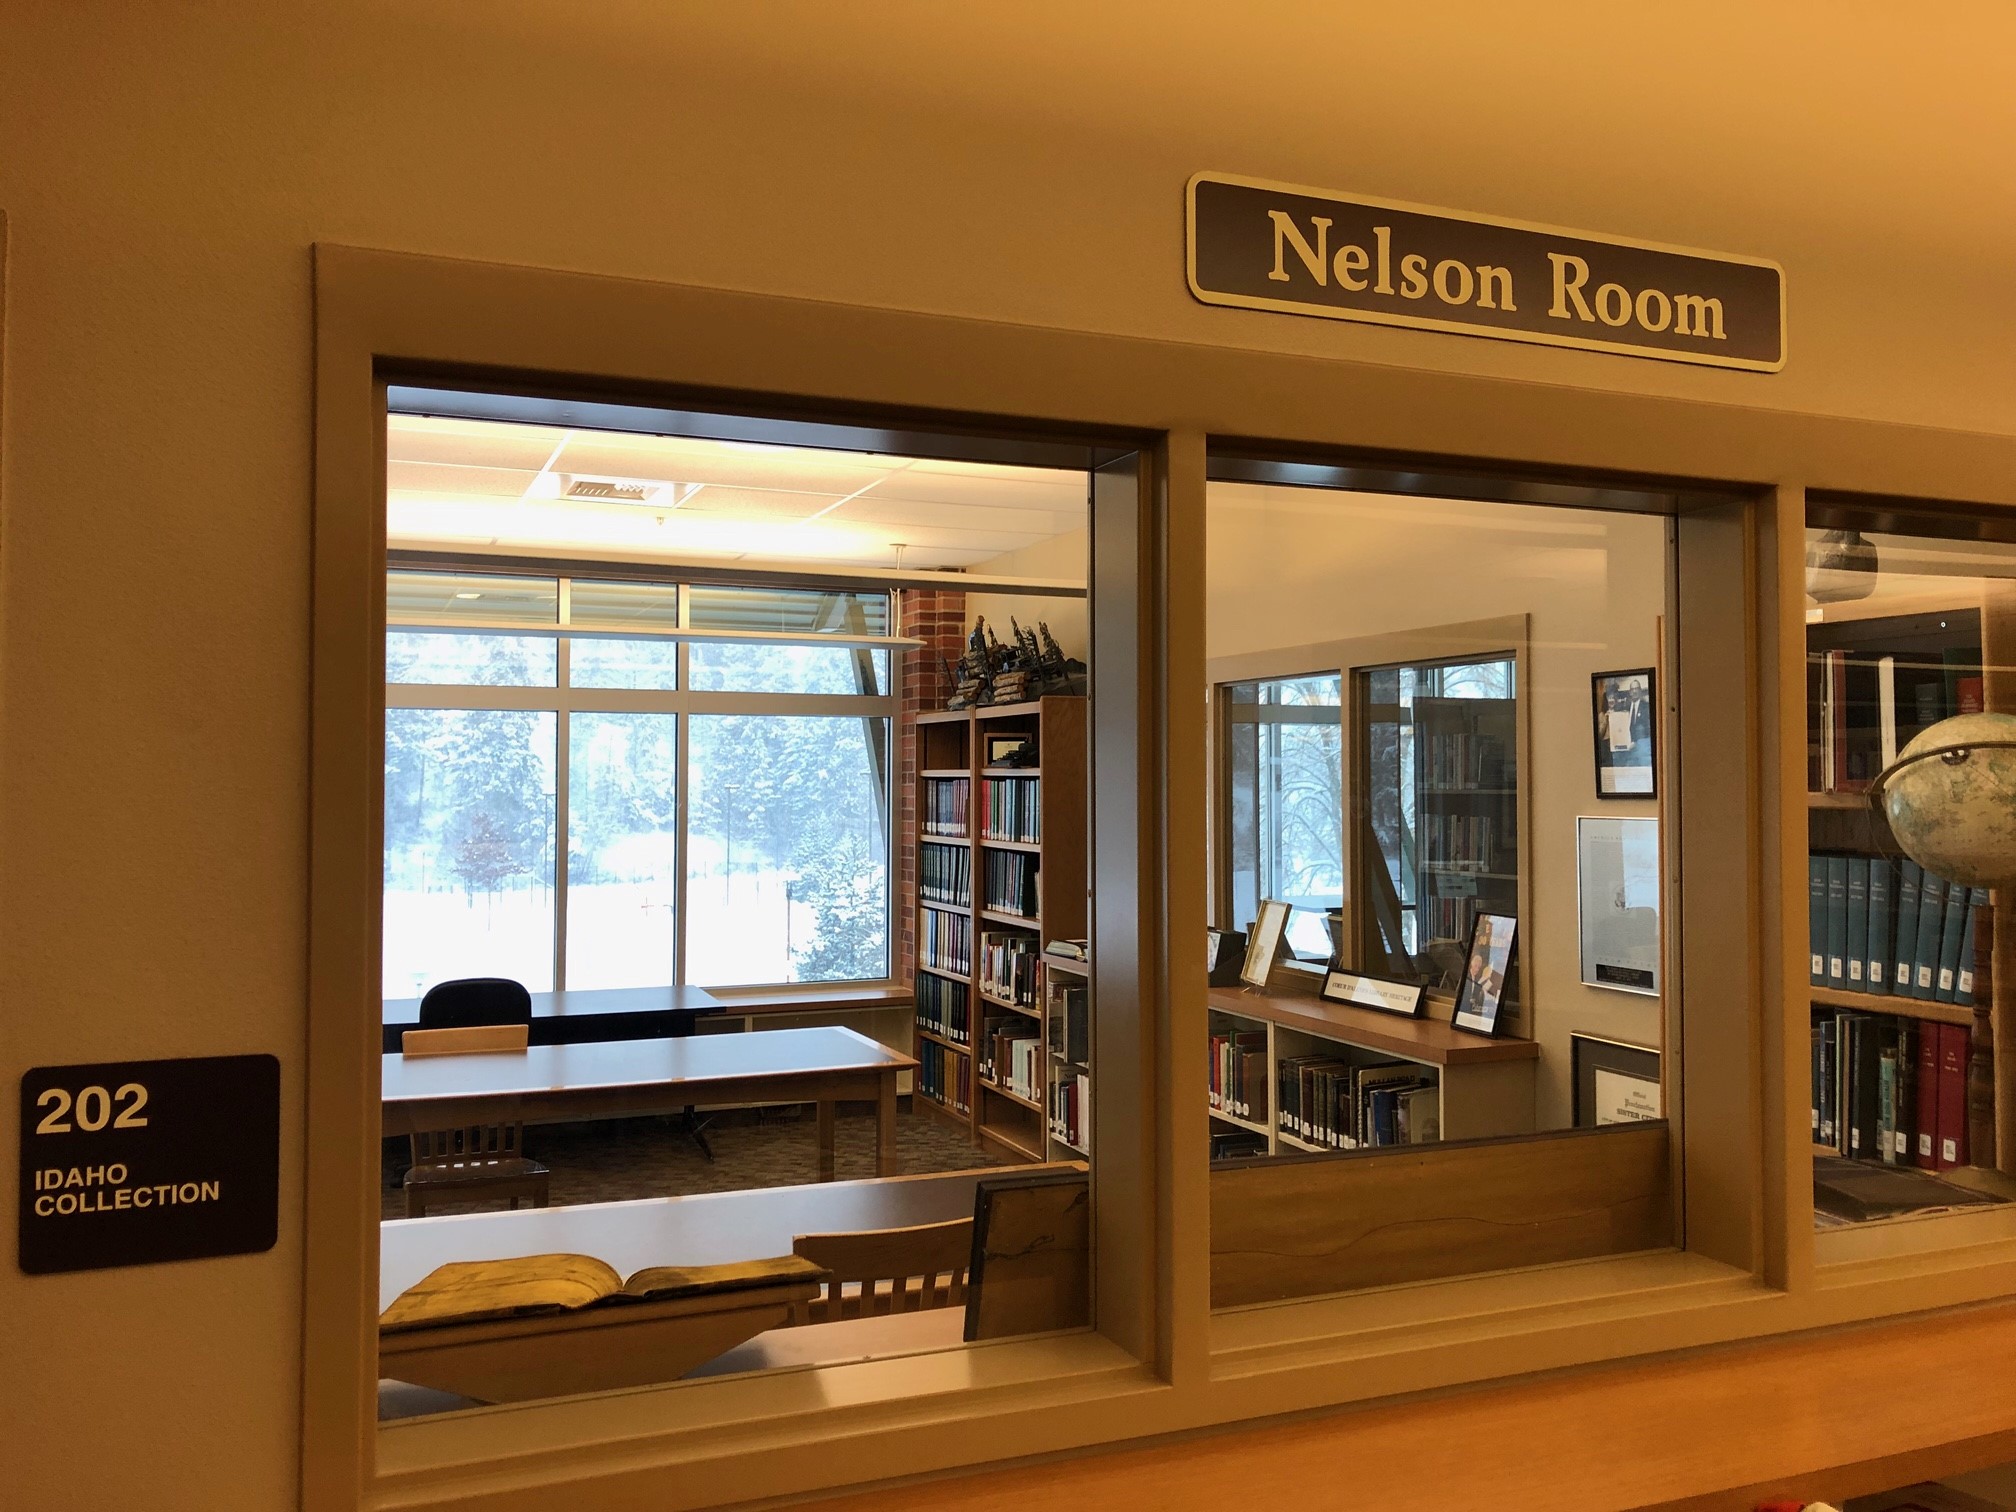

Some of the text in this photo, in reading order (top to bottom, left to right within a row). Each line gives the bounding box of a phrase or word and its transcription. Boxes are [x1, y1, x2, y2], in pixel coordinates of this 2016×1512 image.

[1268, 209, 1727, 339] Nelson Room
[36, 1083, 149, 1135] 202
[34, 1180, 220, 1217] COLLECTION
[35, 1163, 128, 1191] IDAHO
